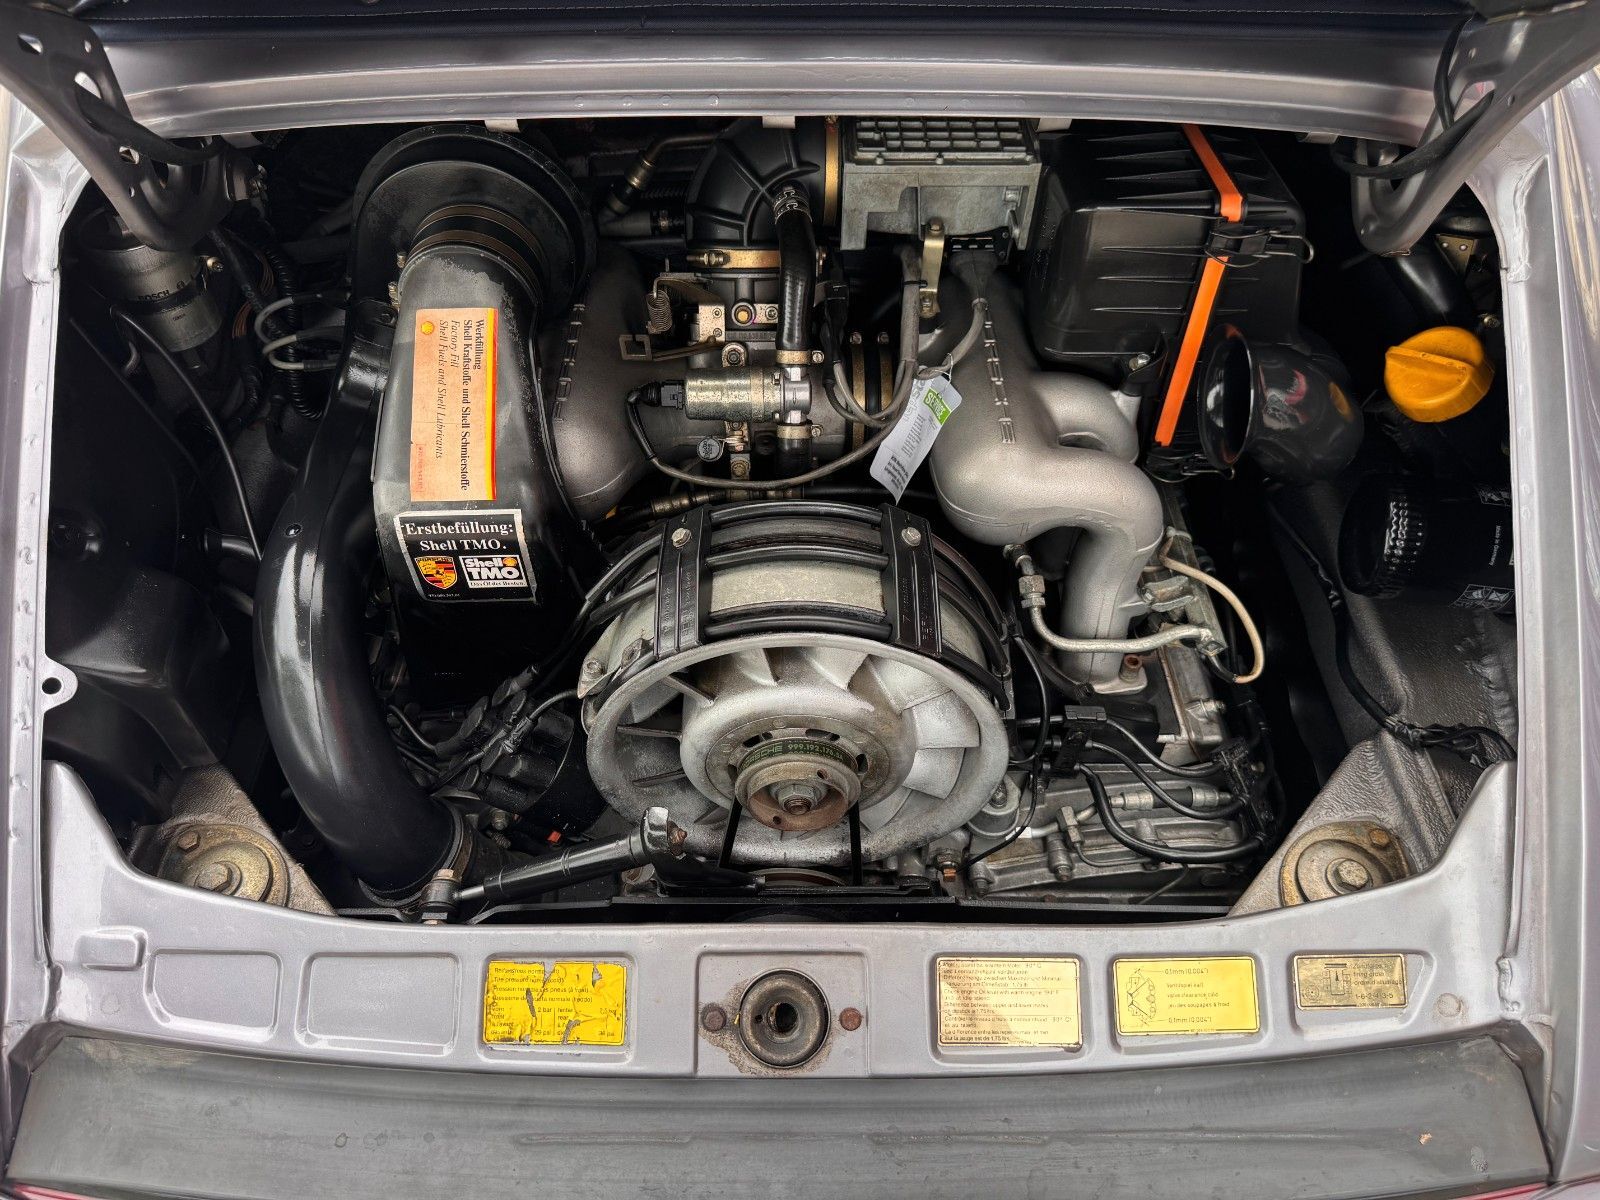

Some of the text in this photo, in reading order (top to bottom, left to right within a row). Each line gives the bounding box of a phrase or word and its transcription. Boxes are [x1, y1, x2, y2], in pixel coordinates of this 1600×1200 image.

[449, 320, 460, 368] Factory Fill
[473, 319, 485, 370] Werkfüllung
[435, 319, 449, 459] Shell Fuels and Shell Lubricants
[460, 319, 473, 491] Shell Kraftstoffe und Shell Schmierstoffe
[405, 521, 514, 536] Erstbefüllung:
[420, 538, 507, 551] Shell TMO.
[464, 557, 503, 568] Shell
[466, 566, 520, 580] TMO
